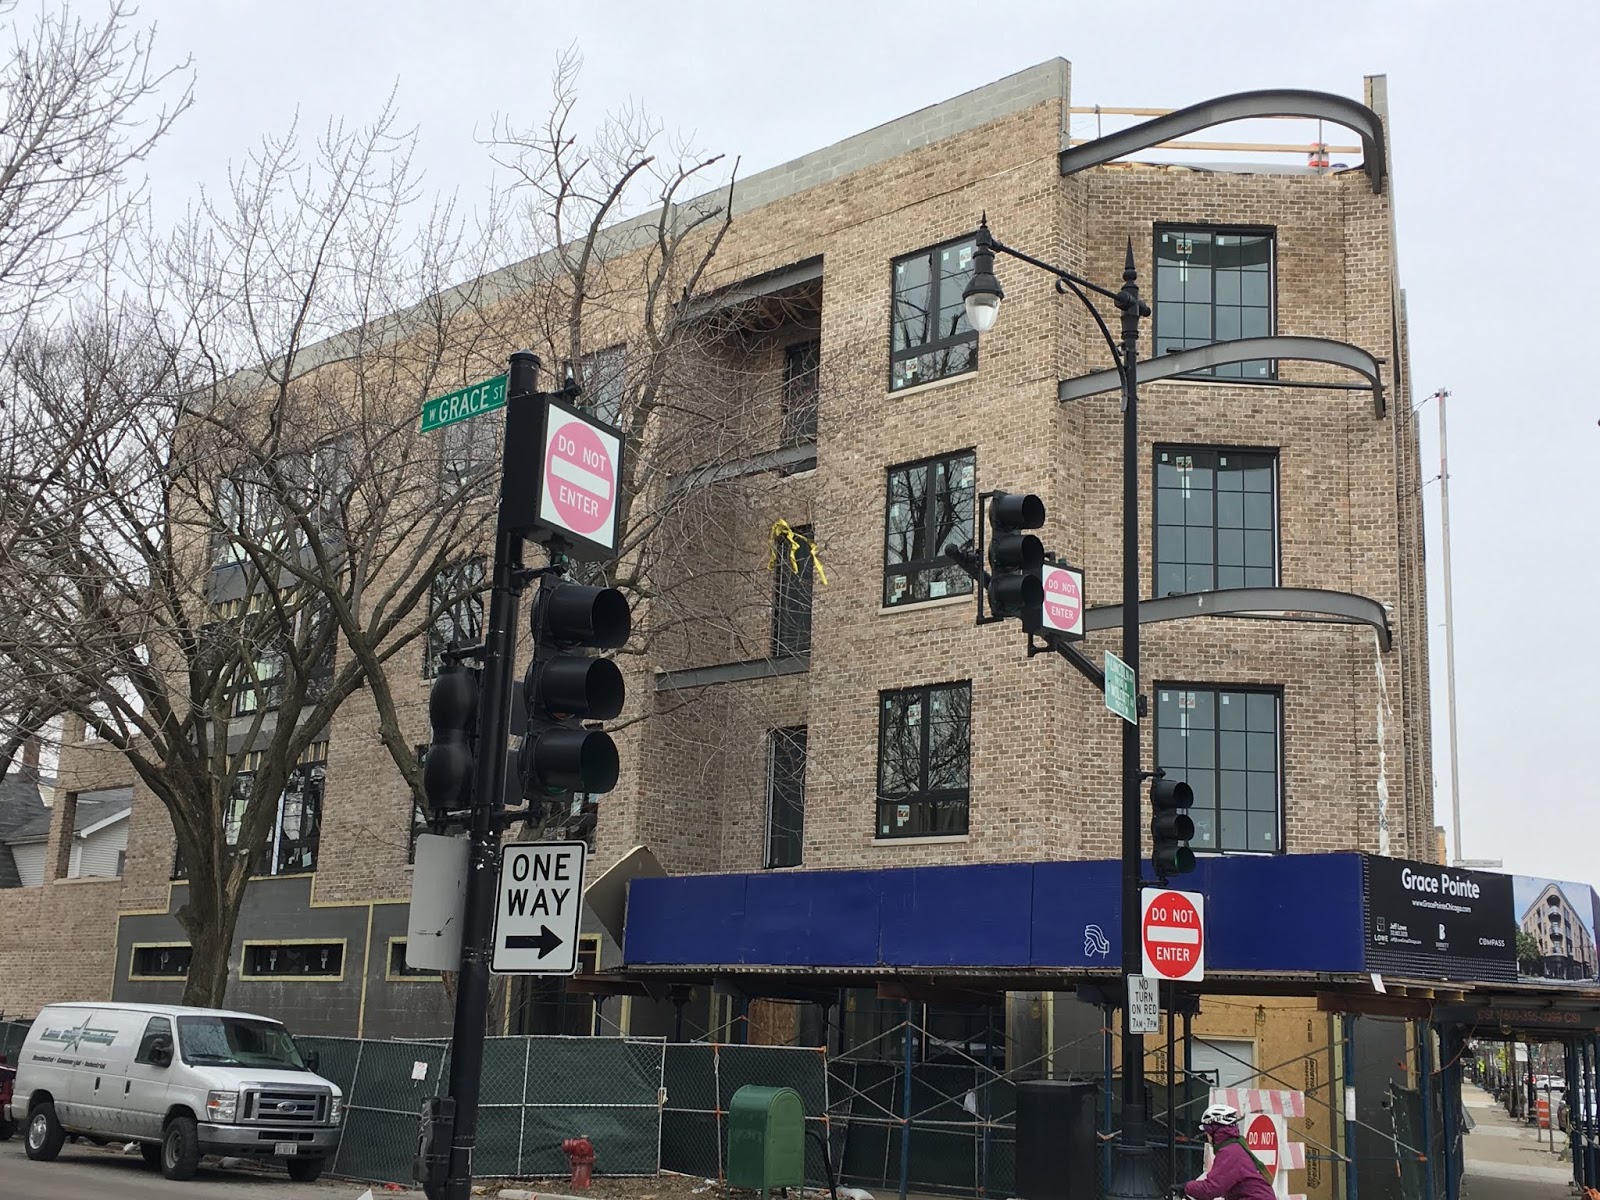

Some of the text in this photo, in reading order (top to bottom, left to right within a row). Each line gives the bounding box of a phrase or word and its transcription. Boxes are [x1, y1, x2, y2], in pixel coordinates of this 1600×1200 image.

[429, 384, 505, 423] W GRACE ST
[558, 435, 606, 472] DO NOT
[559, 485, 599, 518] ENTER
[1048, 578, 1076, 595] DO NOT
[1051, 605, 1074, 620] ENTER
[512, 853, 571, 882] ONE
[1401, 867, 1480, 899] Grace Pointe
[508, 888, 571, 917] WAY
[1152, 907, 1194, 923] DO NOT
[1478, 937, 1505, 947] COMPASS
[1156, 946, 1190, 962] ENTER
[1138, 979, 1149, 990] NO
[1135, 991, 1153, 1003] TURN
[1131, 1003, 1157, 1015] ON RED
[1248, 1131, 1275, 1145] DO NOT
